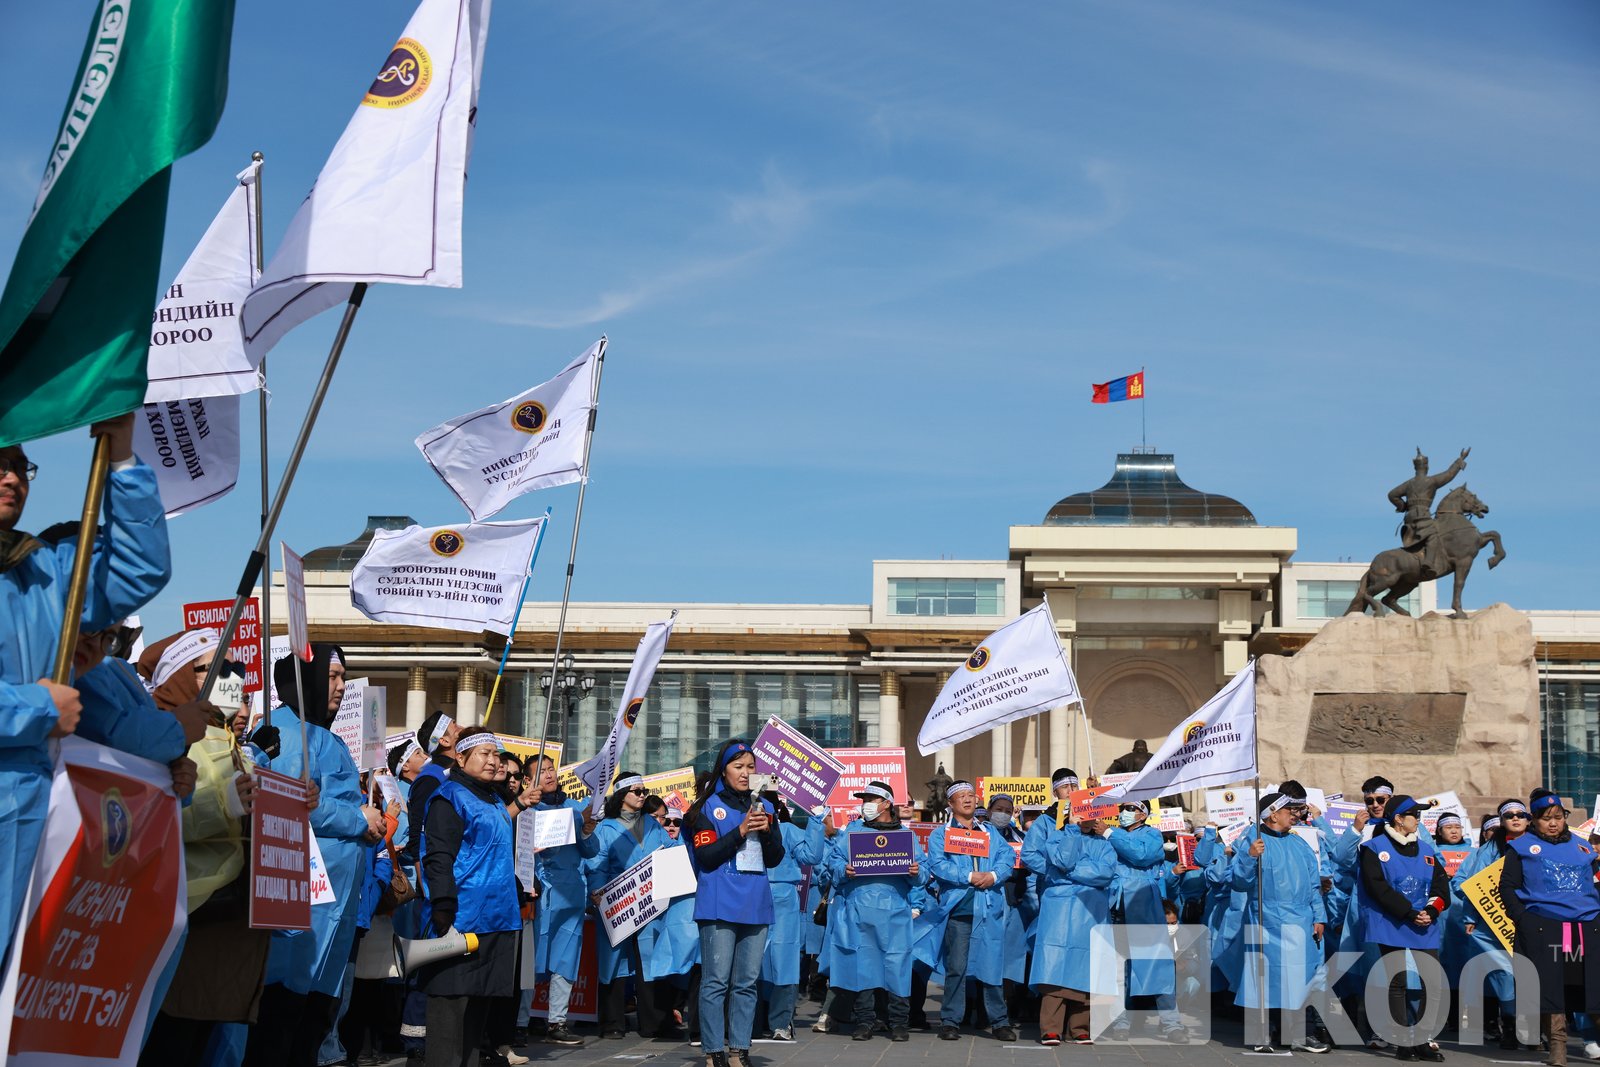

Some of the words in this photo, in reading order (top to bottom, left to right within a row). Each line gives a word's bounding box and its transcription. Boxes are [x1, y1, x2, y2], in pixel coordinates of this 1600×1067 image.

[42, 0, 124, 191] ЭМНЭЛЭ
[188, 397, 210, 440] РХАН
[147, 410, 177, 469] ХОРОО
[377, 576, 443, 587] СУДЛАЛЫН
[447, 579, 503, 593] ҮНДЭСНИЙ
[391, 566, 457, 576] ЗООНОЗЫН
[460, 568, 496, 581] ӨВЧИН
[376, 587, 423, 598] ТӨВИЙН
[426, 590, 468, 602] ҮЭ-ИЙН
[240, 623, 257, 641] БУС
[953, 666, 1019, 699] НИЙСЛЭЛИЙН
[962, 679, 1011, 705] АМАРЖИХ
[1011, 667, 1050, 685] ГАЗРЫН
[955, 697, 994, 716] ҮЭ-ИЙН
[995, 685, 1029, 703] ХОРОО
[1200, 733, 1241, 750] ТӨВИЙН
[763, 741, 783, 759] ТУЛАА
[801, 768, 827, 789] БАЙГААГ
[779, 739, 809, 763] СУВИЛАГЧ
[809, 760, 823, 772] НАР
[1181, 749, 1215, 767] ХОРОО
[780, 767, 801, 784] ХҮНИЙ
[860, 762, 902, 776] НӨӨЦИЙН
[990, 783, 1046, 793] АЖИЛЛАСААР
[852, 859, 886, 868] ШУДАРГА
[887, 858, 912, 868] ЦАЛИН
[605, 878, 637, 905] БИДНИЙ
[604, 893, 637, 920] БАНКНЫ
[633, 905, 659, 927] БАЙНА.
[611, 907, 635, 929] БОСГО
